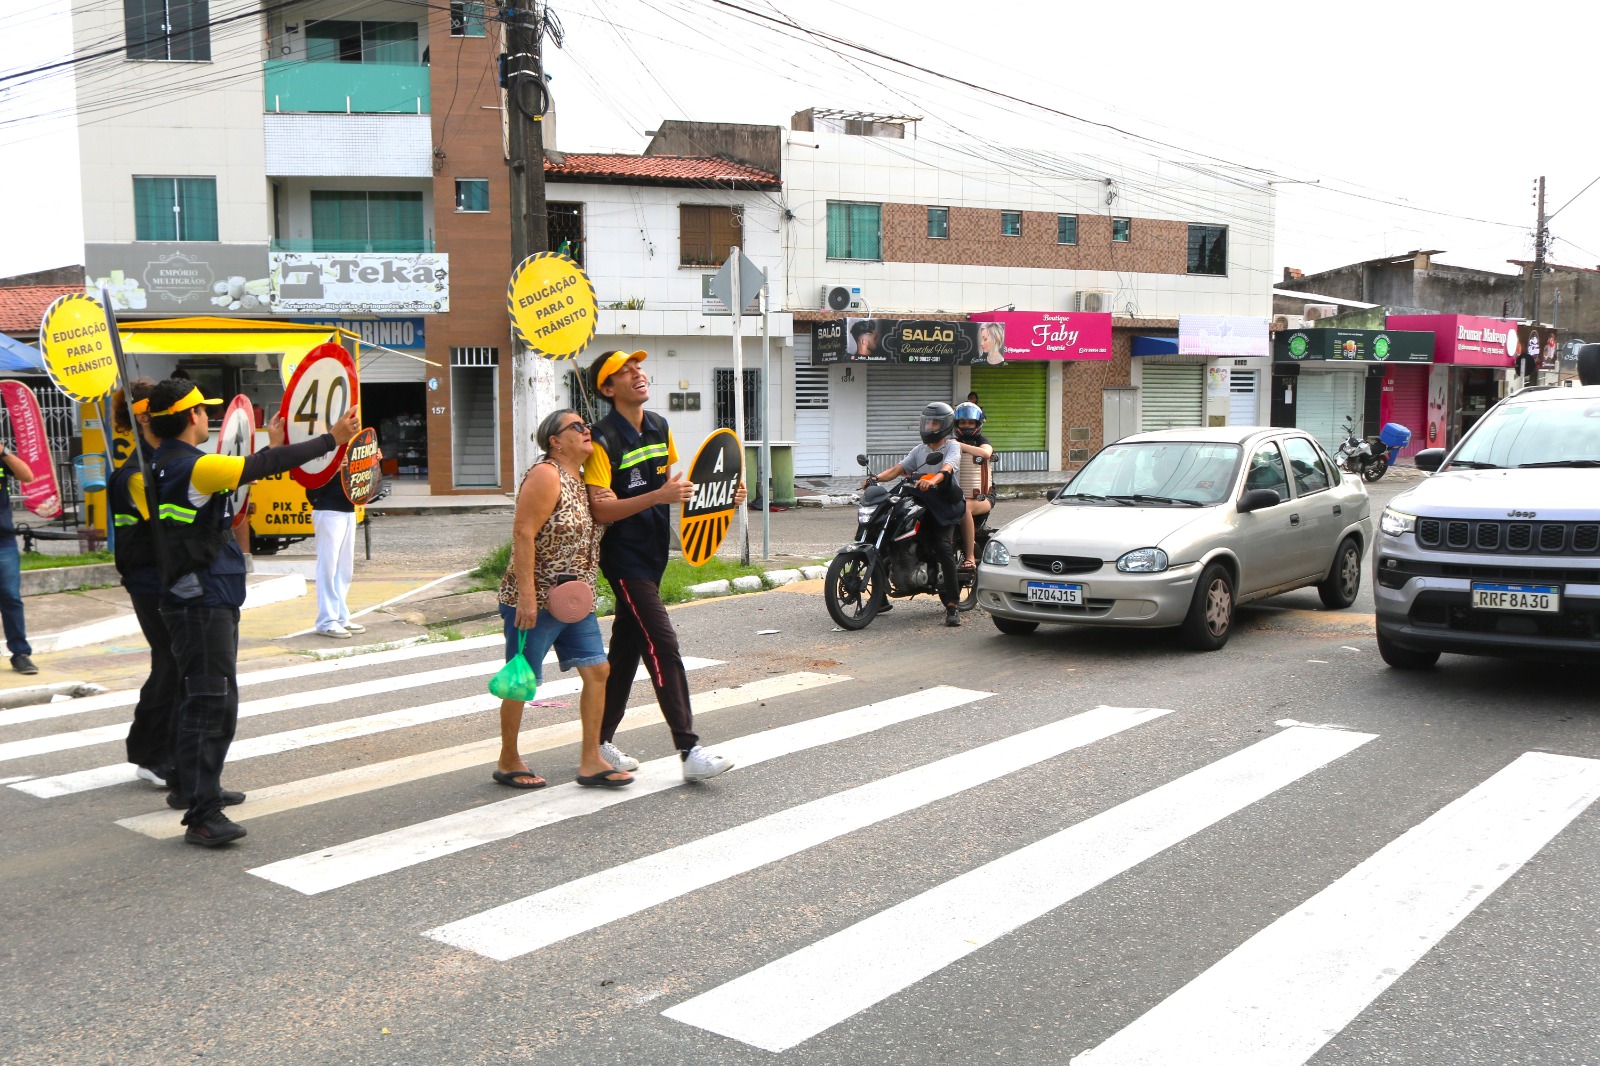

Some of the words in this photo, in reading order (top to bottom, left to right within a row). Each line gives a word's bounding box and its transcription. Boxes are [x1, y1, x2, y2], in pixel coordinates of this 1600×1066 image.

[152, 277, 206, 285] MULTIGRÃOS
[160, 268, 198, 276] EMPÓRIO
[330, 260, 435, 284] Teka
[519, 275, 577, 309] EDUCAÇÃO
[536, 300, 565, 320] PARA
[566, 295, 574, 305] O
[535, 308, 587, 339] TRÂNSITO
[1043, 314, 1069, 324] Boutique
[53, 322, 107, 343] EDUCAÇÃO
[314, 321, 414, 345] ARINHO
[817, 324, 841, 339] SALÃO
[902, 326, 954, 342] SALÃO
[1031, 324, 1079, 347] Faby
[1482, 328, 1507, 347] Makeup
[66, 343, 94, 358] PARA
[96, 341, 102, 350] O
[901, 343, 934, 356] Beautiful
[934, 343, 955, 354] Hair
[63, 356, 112, 376] TRÂNSITO
[294, 376, 348, 435] 40
[16, 387, 39, 463] MULTIGRÃOS
[713, 447, 723, 474] A
[688, 480, 727, 511] FAIXA
[727, 472, 738, 505] É
[272, 502, 292, 511] PIX
[302, 502, 309, 511] E
[1507, 510, 1536, 519] Jeep
[265, 511, 312, 524] CARTÕE
[1031, 588, 1076, 602] HZQ4J15
[1479, 591, 1549, 609] RRF8A30
